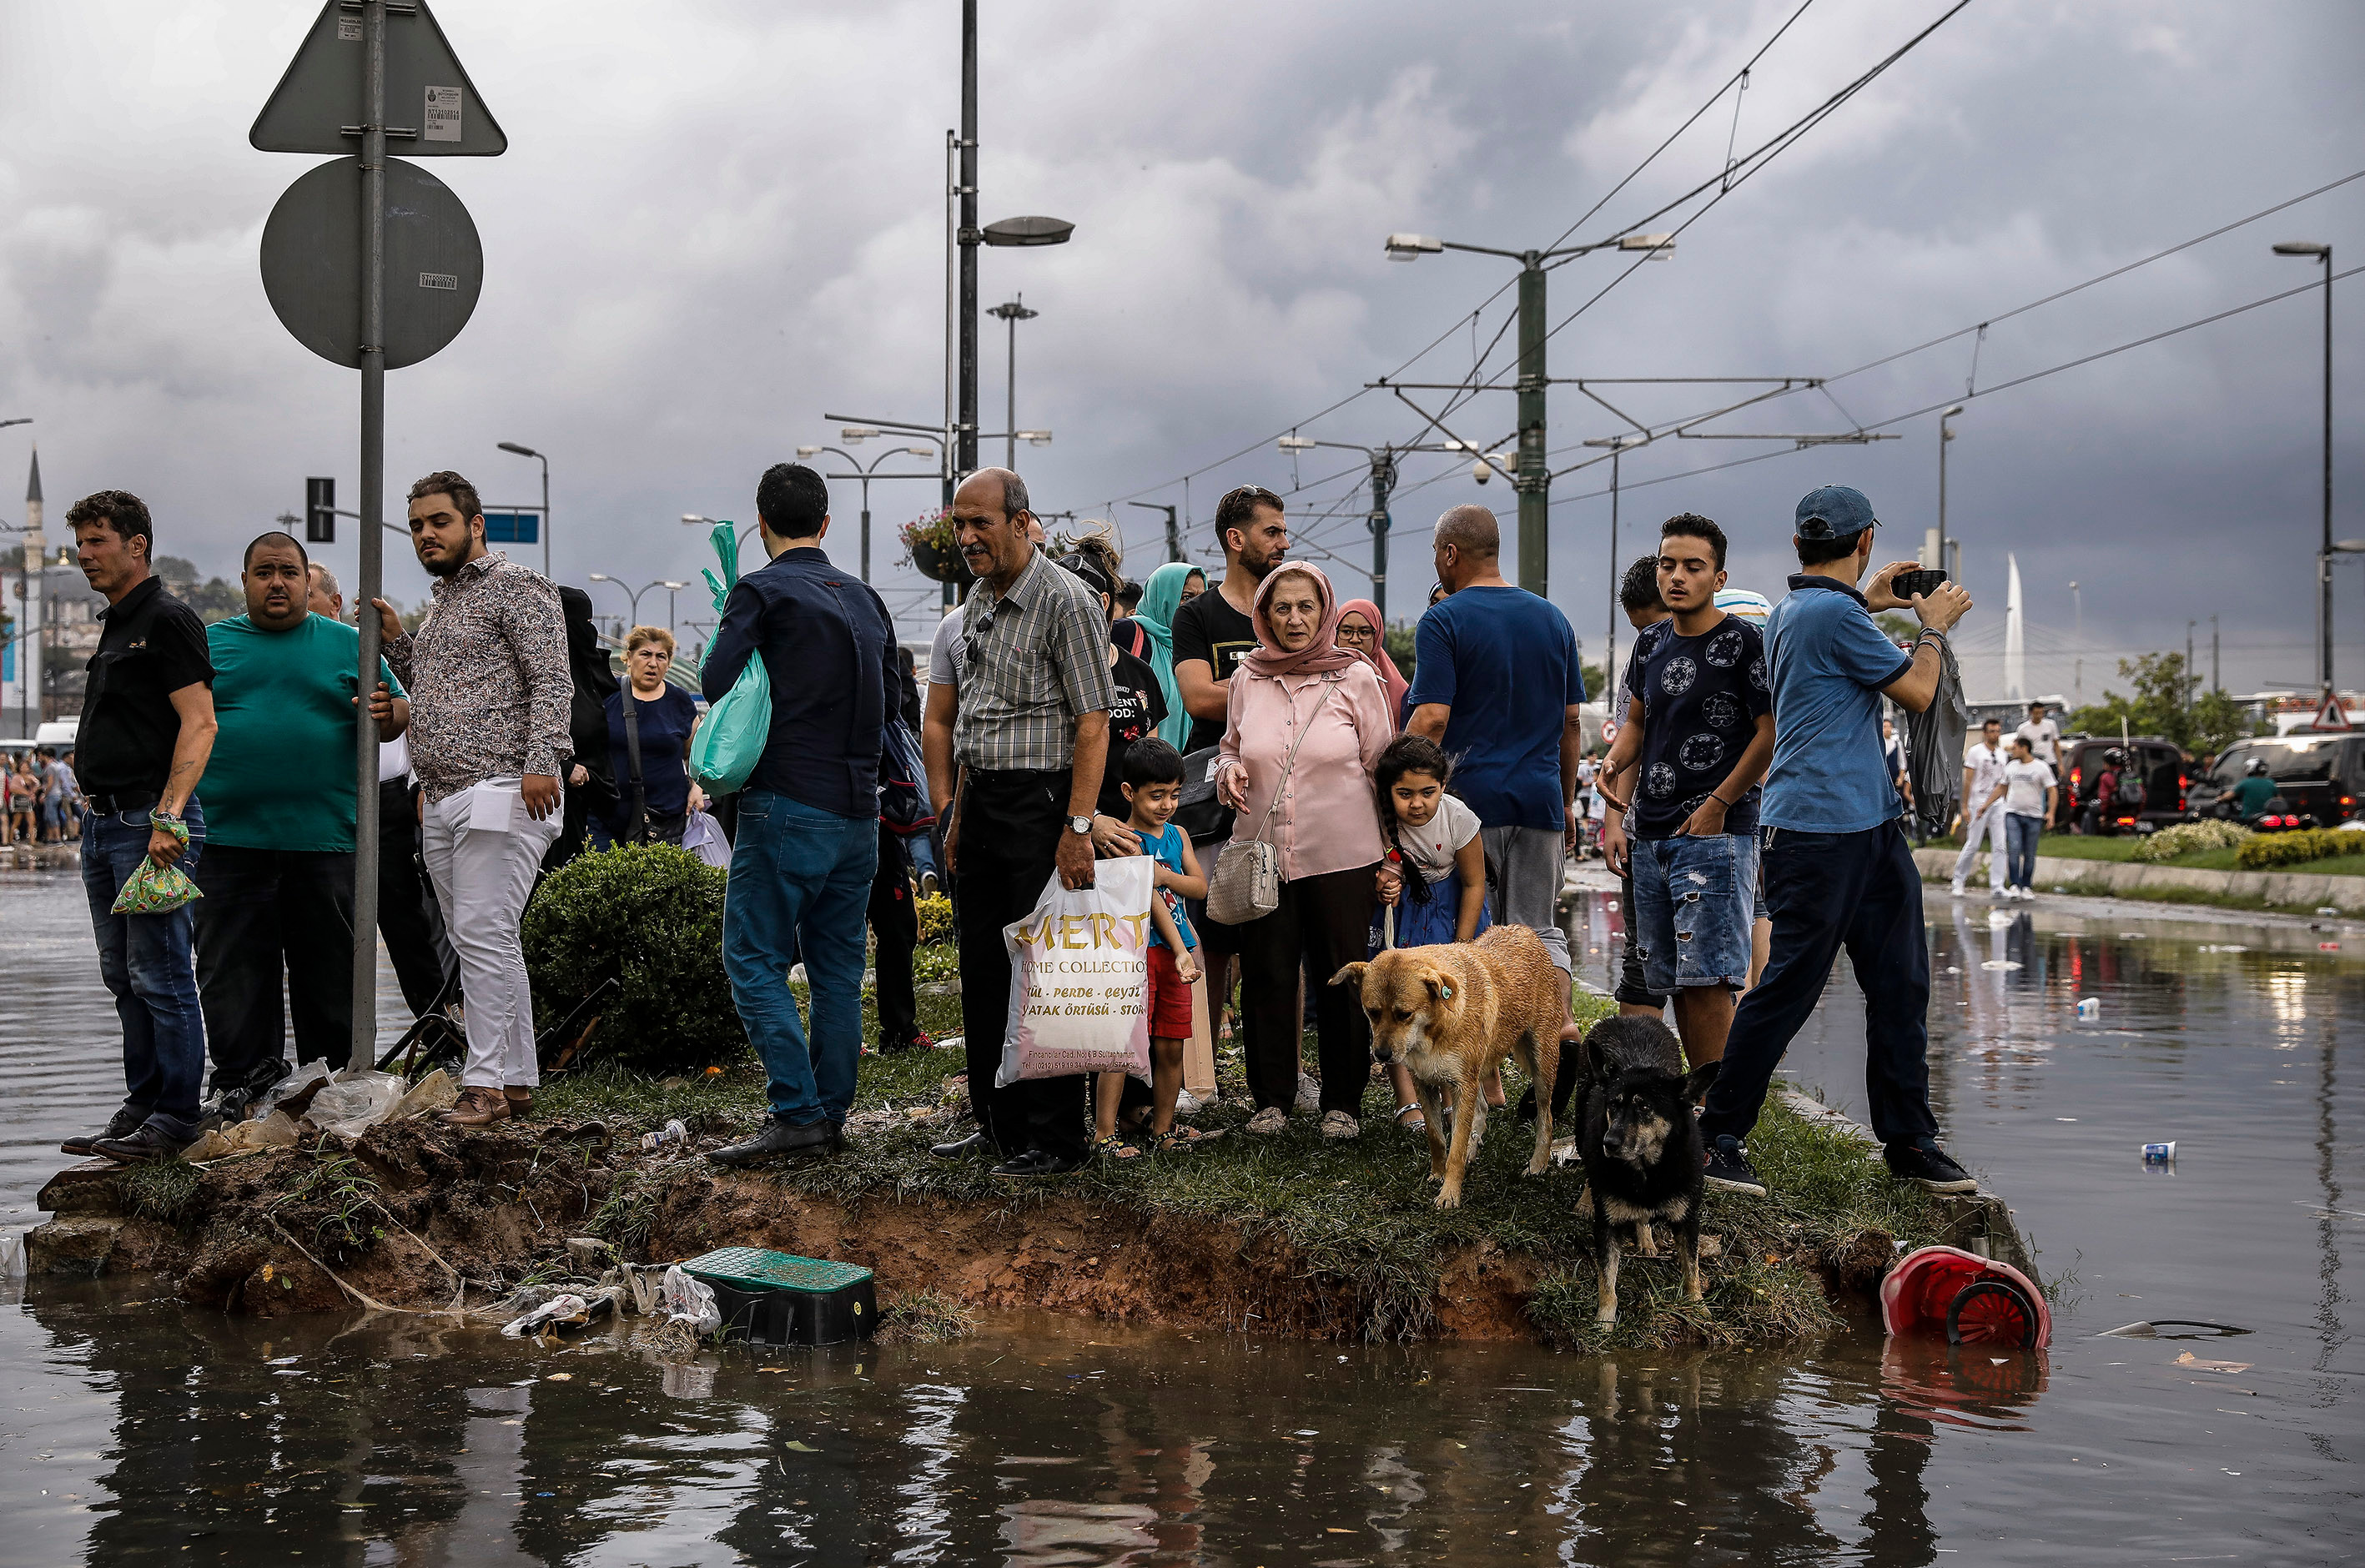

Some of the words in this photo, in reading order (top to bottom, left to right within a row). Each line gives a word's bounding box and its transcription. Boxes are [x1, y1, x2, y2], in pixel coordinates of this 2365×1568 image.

[1014, 911, 1150, 951] MERT
[1021, 961, 1054, 973] HOME
[1053, 988, 1094, 998] PERDE
[1022, 1004, 1061, 1017] YATAK
[1064, 1003, 1110, 1016] ÖRTÜSÜ
[1120, 1004, 1145, 1016] STOR
[1062, 1050, 1075, 1058] Cad.
[1035, 1062, 1054, 1070] (0212)
